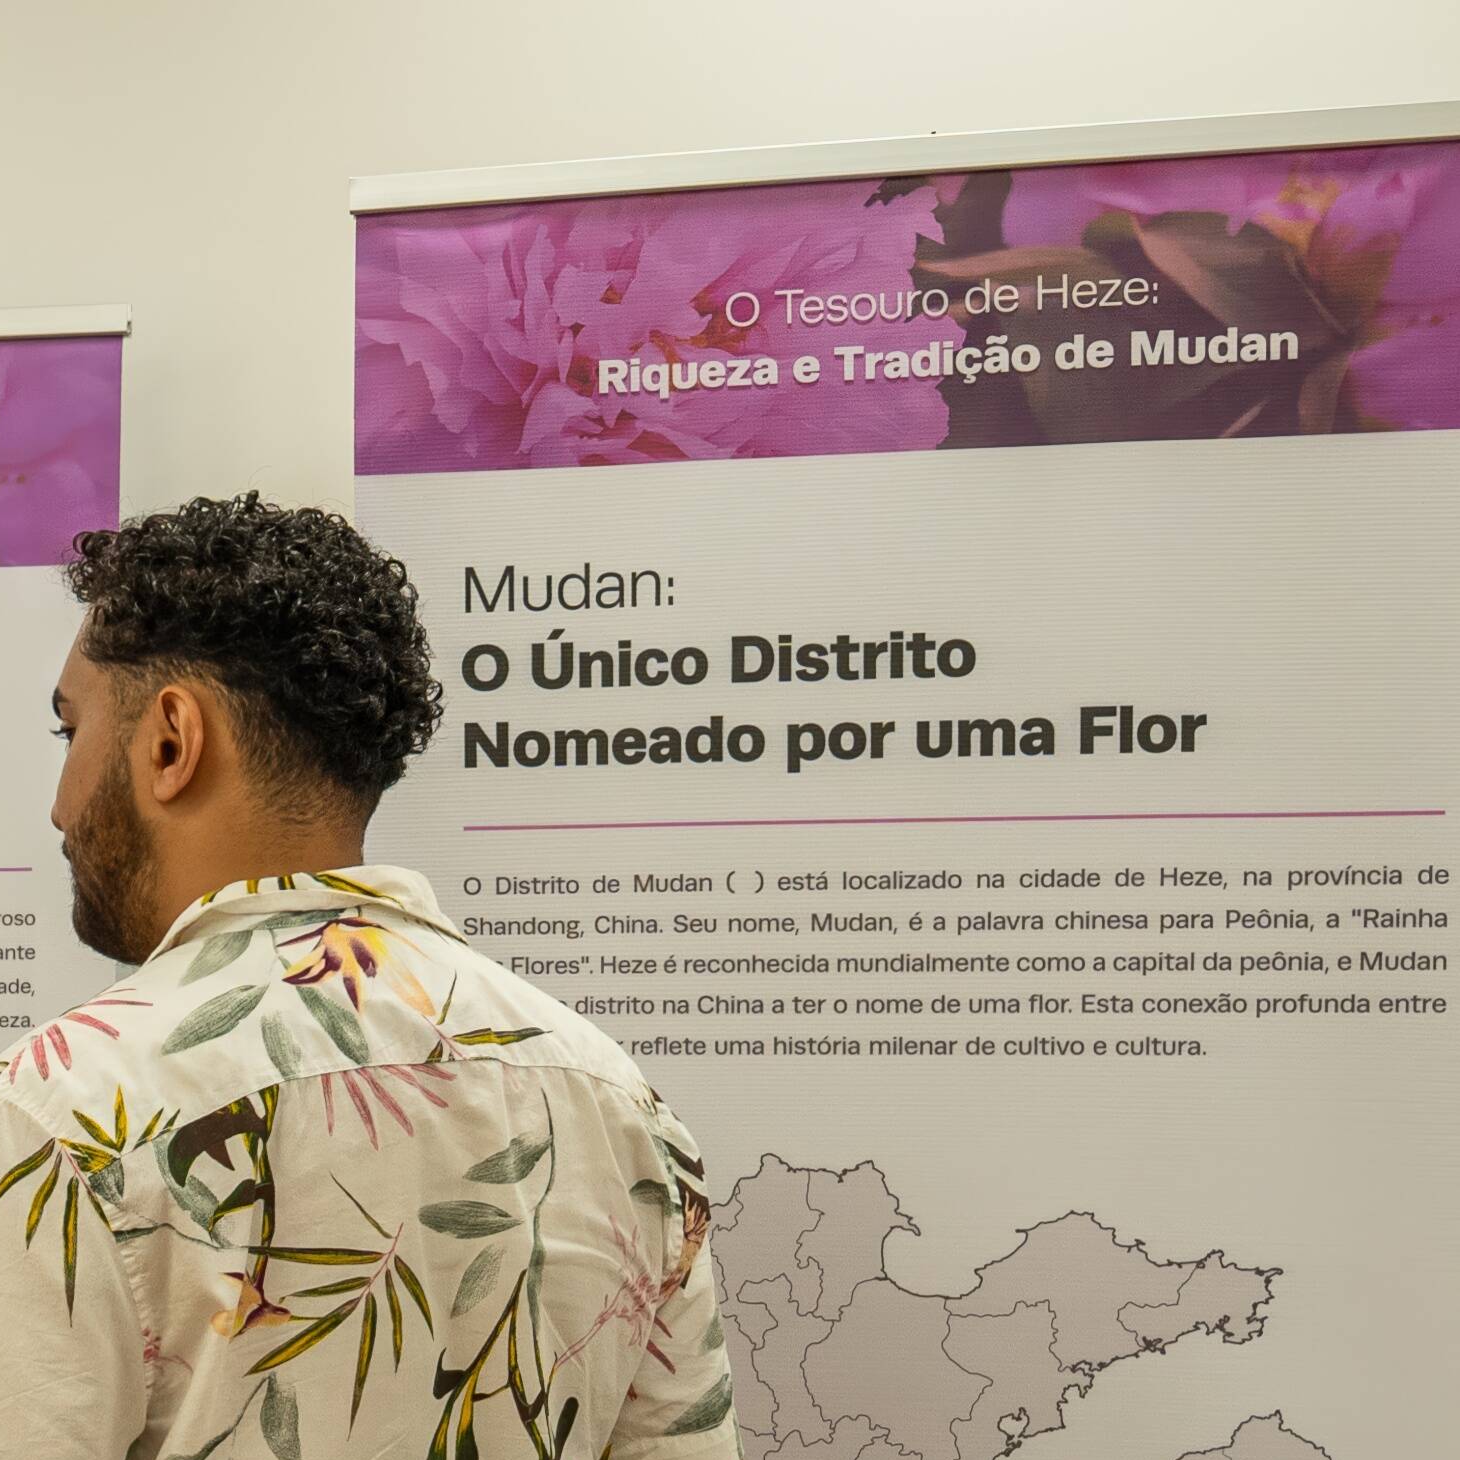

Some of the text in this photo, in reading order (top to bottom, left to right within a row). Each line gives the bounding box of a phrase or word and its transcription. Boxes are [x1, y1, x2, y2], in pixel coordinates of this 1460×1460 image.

[725, 271, 1159, 329] O Tesouro de Heze:
[597, 324, 1299, 399] Riqueza e Tradição de Mudan
[464, 561, 674, 614] Mudan:
[460, 627, 976, 692] O Único Distrito
[463, 704, 1208, 774] Nomeado por uma Flor
[462, 907, 1448, 938] Shandong, China. Seu nome, Mudan, é a palavra chinesa para Peônia, a "Rainha
[630, 1034, 1207, 1056] reflete uma história milenar de cultivo e cultura.
